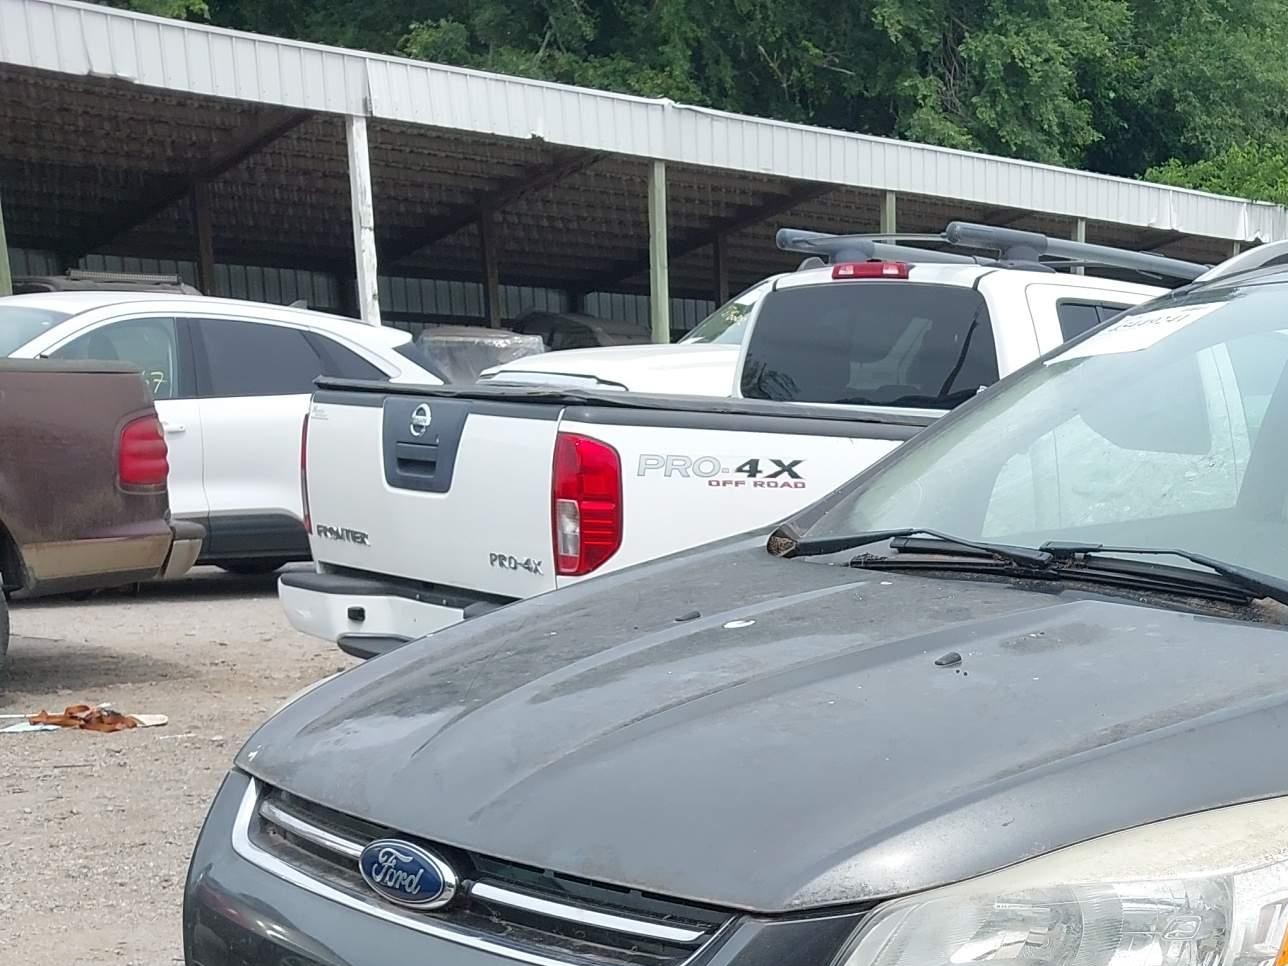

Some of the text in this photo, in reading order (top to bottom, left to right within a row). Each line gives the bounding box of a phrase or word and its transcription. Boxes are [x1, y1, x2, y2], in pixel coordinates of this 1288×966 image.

[637, 453, 807, 480] PRO-4X
[708, 479, 806, 489] OFF ROAD
[489, 552, 544, 576] PRO-4X
[371, 847, 424, 895] Ford
